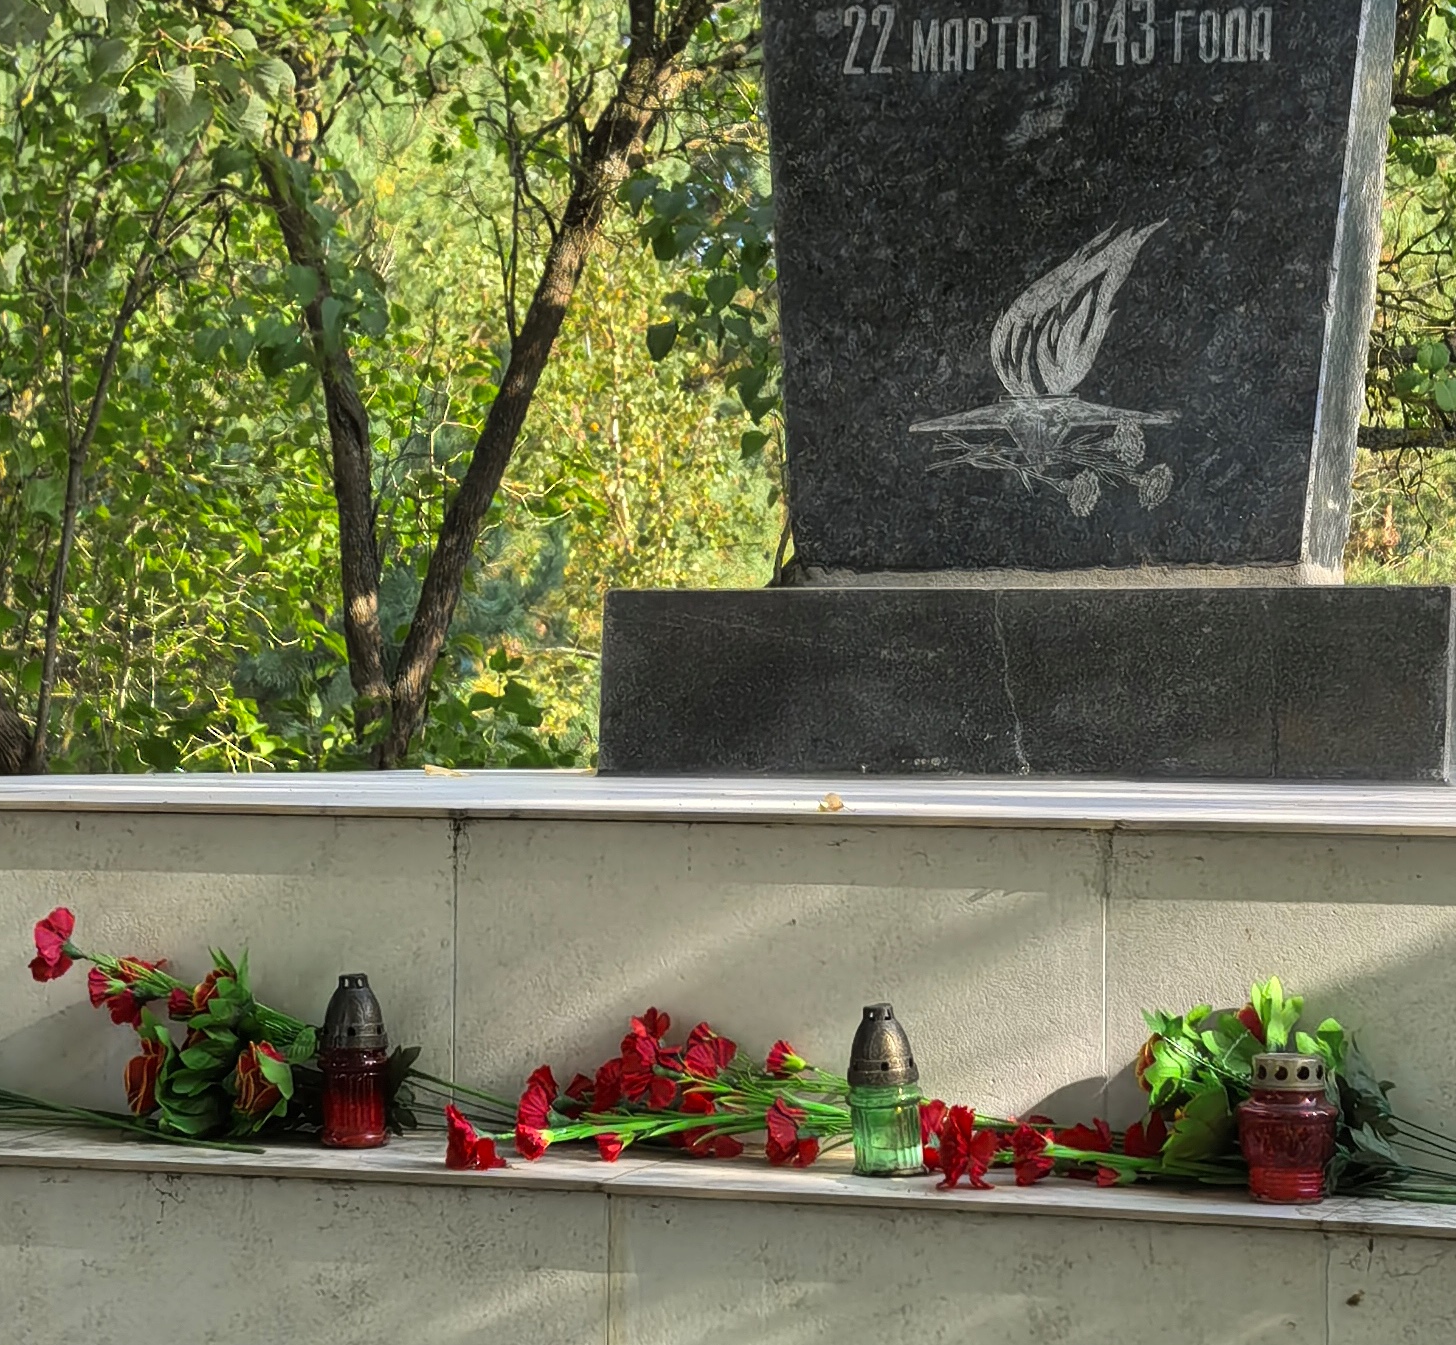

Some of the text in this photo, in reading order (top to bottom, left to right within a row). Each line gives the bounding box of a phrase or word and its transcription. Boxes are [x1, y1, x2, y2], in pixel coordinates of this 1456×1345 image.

[843, 3, 896, 76] 22
[910, 14, 1039, 73] МАРТА
[1173, 5, 1273, 65] ГОДА
